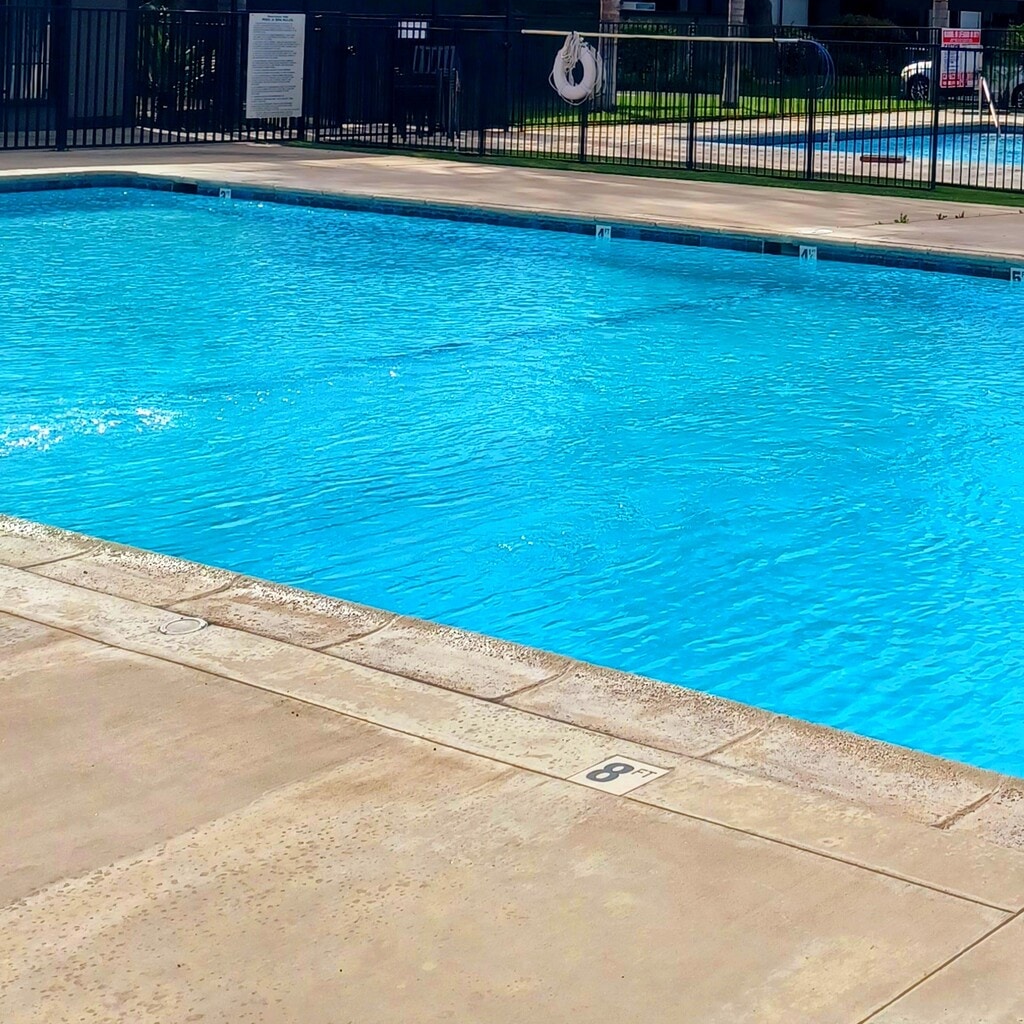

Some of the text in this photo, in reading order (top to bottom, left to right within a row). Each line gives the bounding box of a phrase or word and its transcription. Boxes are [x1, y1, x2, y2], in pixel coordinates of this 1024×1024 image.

[1012, 270, 1022, 282] 5
[585, 762, 657, 783] 8 FT
